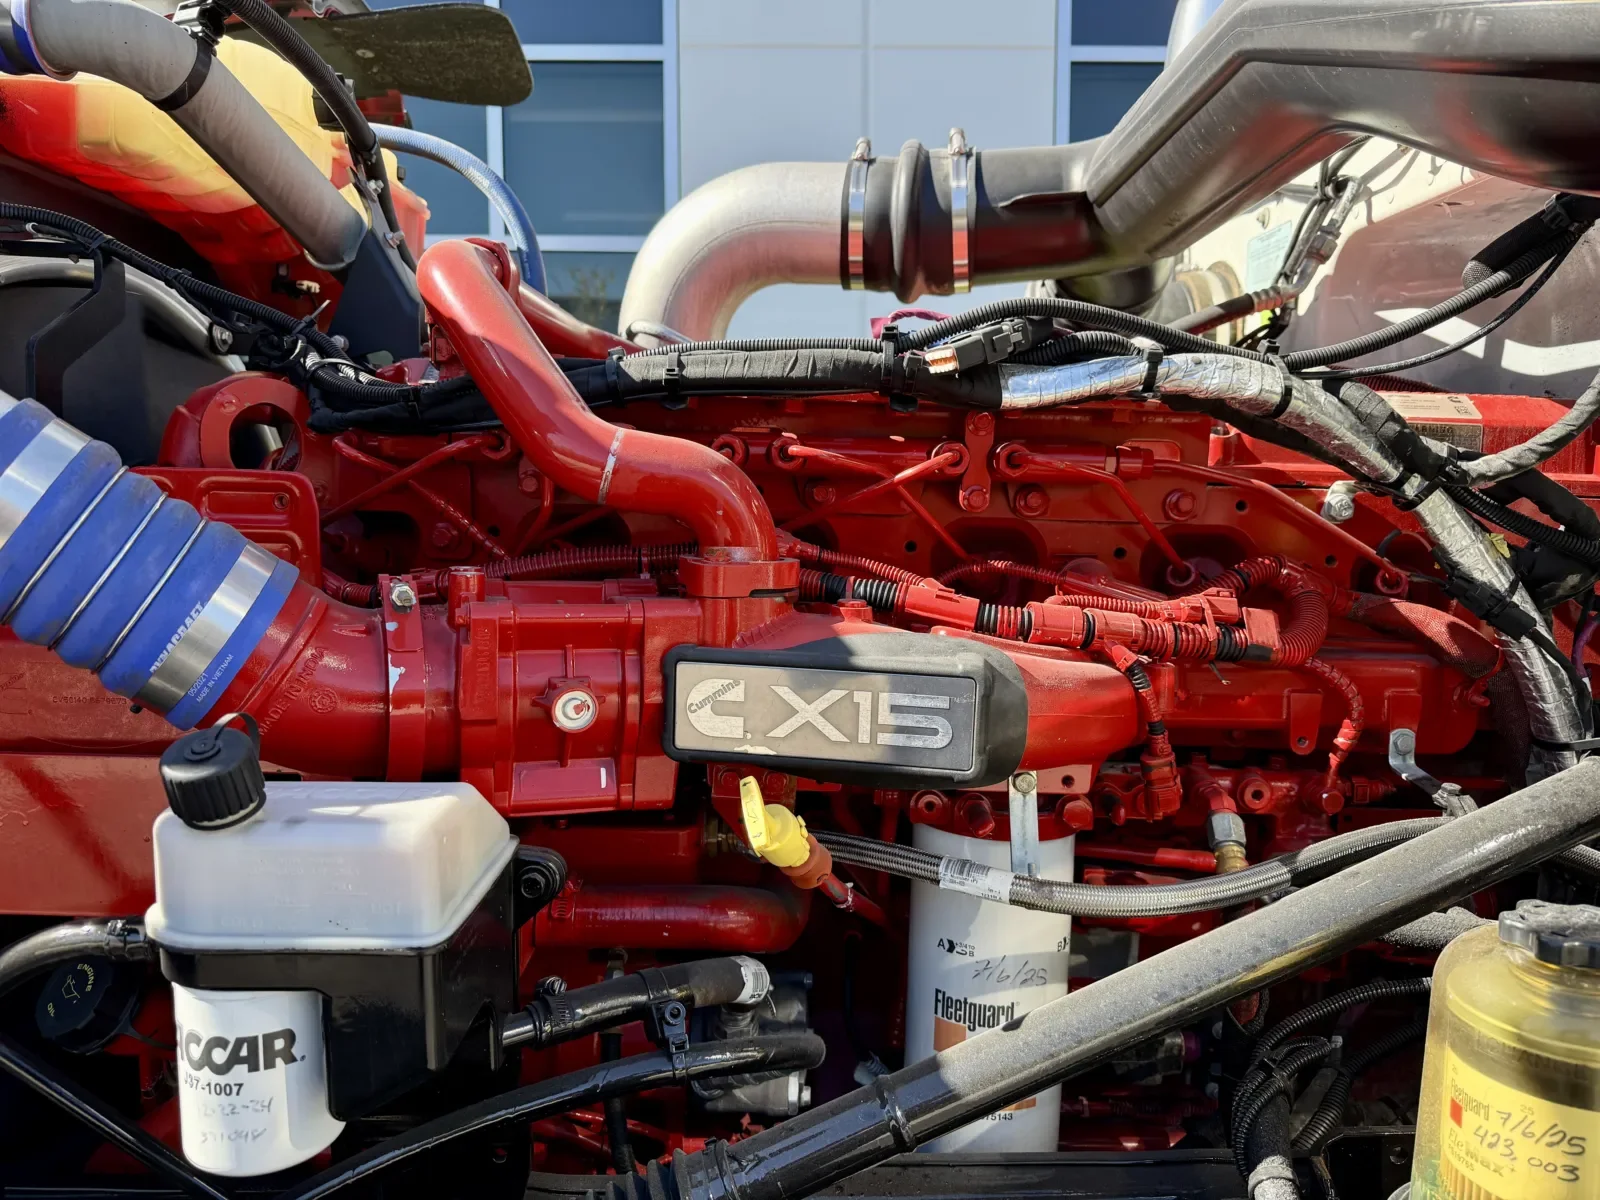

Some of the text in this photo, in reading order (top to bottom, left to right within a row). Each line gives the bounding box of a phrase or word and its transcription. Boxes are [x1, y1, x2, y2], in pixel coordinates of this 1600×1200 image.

[187, 672, 208, 697] 05/2021
[195, 685, 210, 703] MADE
[211, 653, 234, 681] VIETNAM
[688, 678, 741, 714] Cummins
[765, 685, 953, 749] X15
[937, 938, 946, 950] A
[77, 963, 95, 992] ENGINE
[972, 955, 1047, 987] 7/6/25
[47, 1002, 56, 1017] OIL
[934, 987, 1015, 1032] Fleetguard
[1496, 1110, 1587, 1157] 7/6/25
